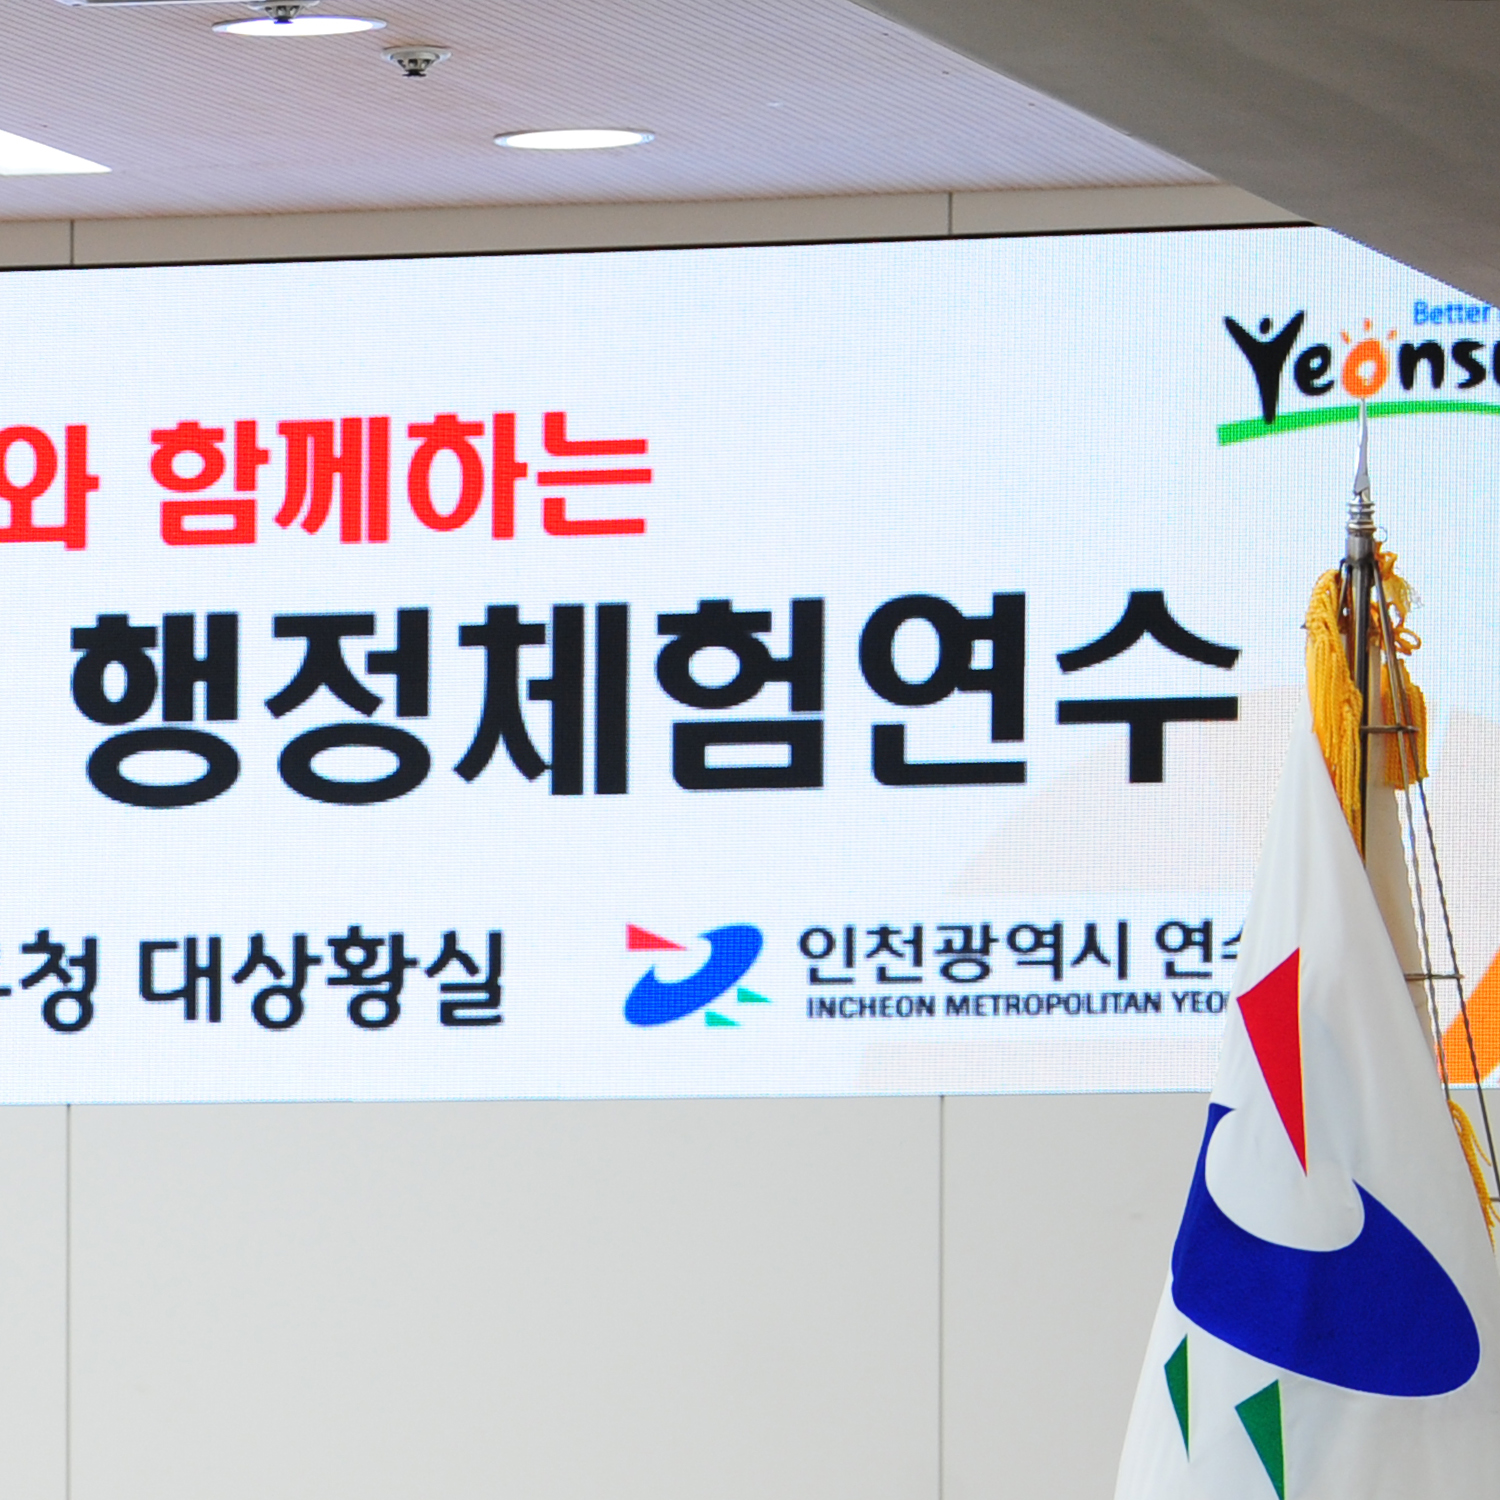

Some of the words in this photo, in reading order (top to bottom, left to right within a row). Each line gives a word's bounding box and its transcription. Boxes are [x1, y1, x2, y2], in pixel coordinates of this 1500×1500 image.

[1221, 308, 1500, 425] Yeons
[1413, 300, 1491, 325] Better
[149, 411, 654, 548] 함께하는
[72, 590, 1242, 810] 행정체험연수
[139, 924, 505, 1032] 대상황실
[799, 921, 1129, 985] 인천광역시
[806, 996, 936, 1019] INCHEON
[945, 992, 1162, 1018] METROPOLITAN
[1172, 991, 1229, 1013] YEO
